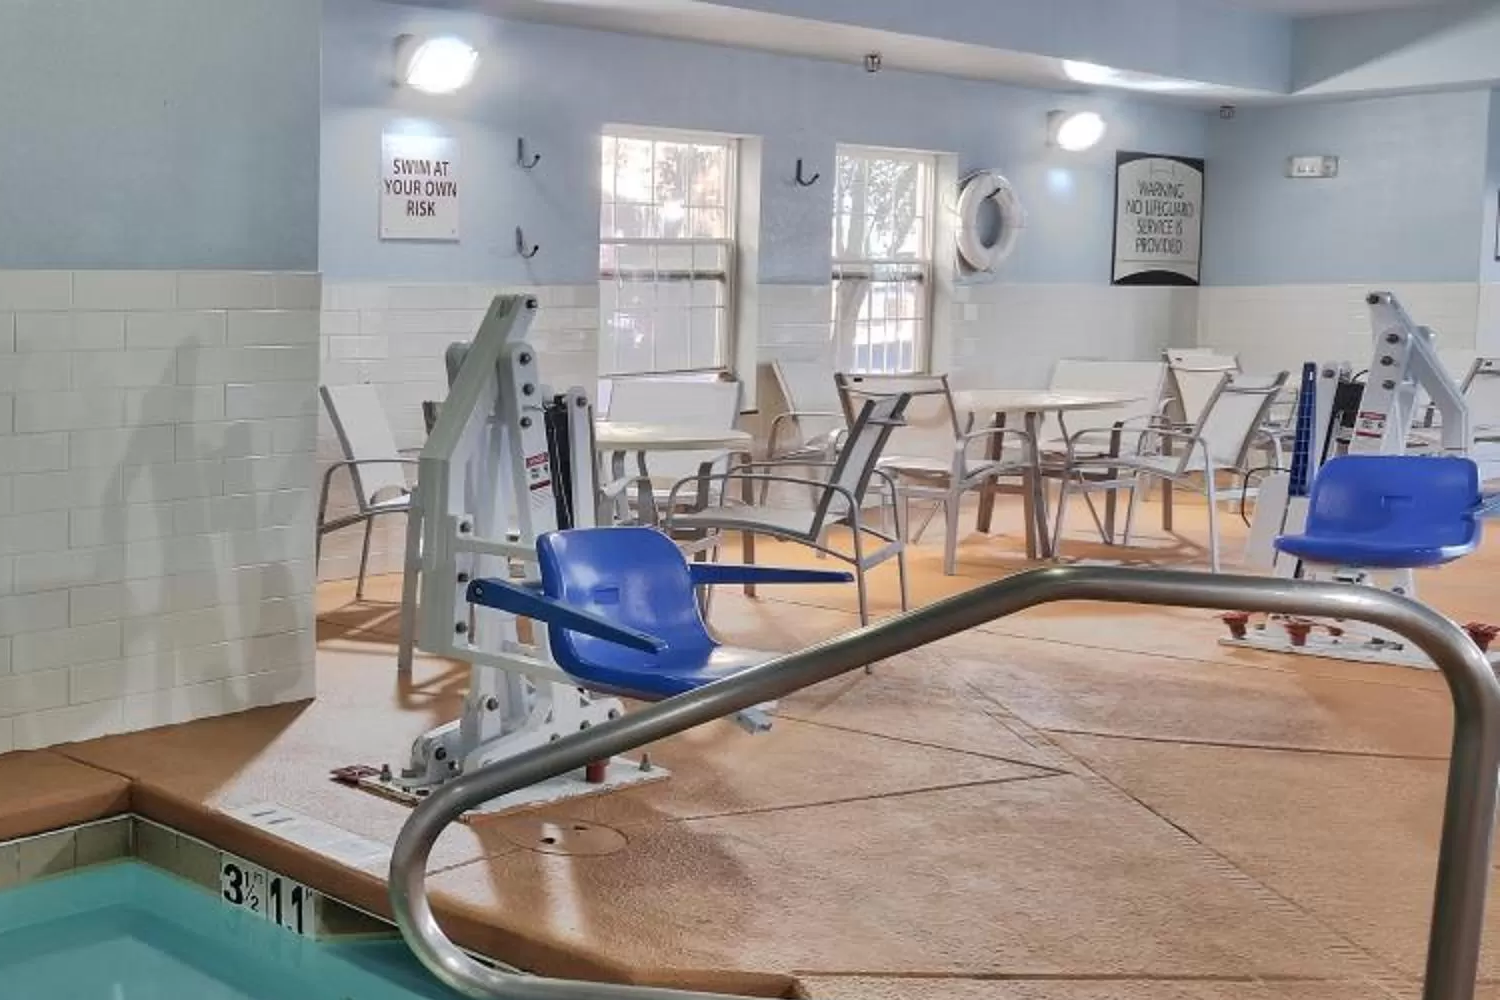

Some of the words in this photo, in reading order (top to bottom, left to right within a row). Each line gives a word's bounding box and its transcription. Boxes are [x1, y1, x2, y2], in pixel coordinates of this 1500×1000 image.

[393, 158, 430, 176] SWIM
[433, 161, 449, 177] AT
[384, 179, 421, 195] YOUR
[425, 181, 457, 198] OWN
[406, 200, 436, 217] RISK
[1125, 199, 1143, 215] NO
